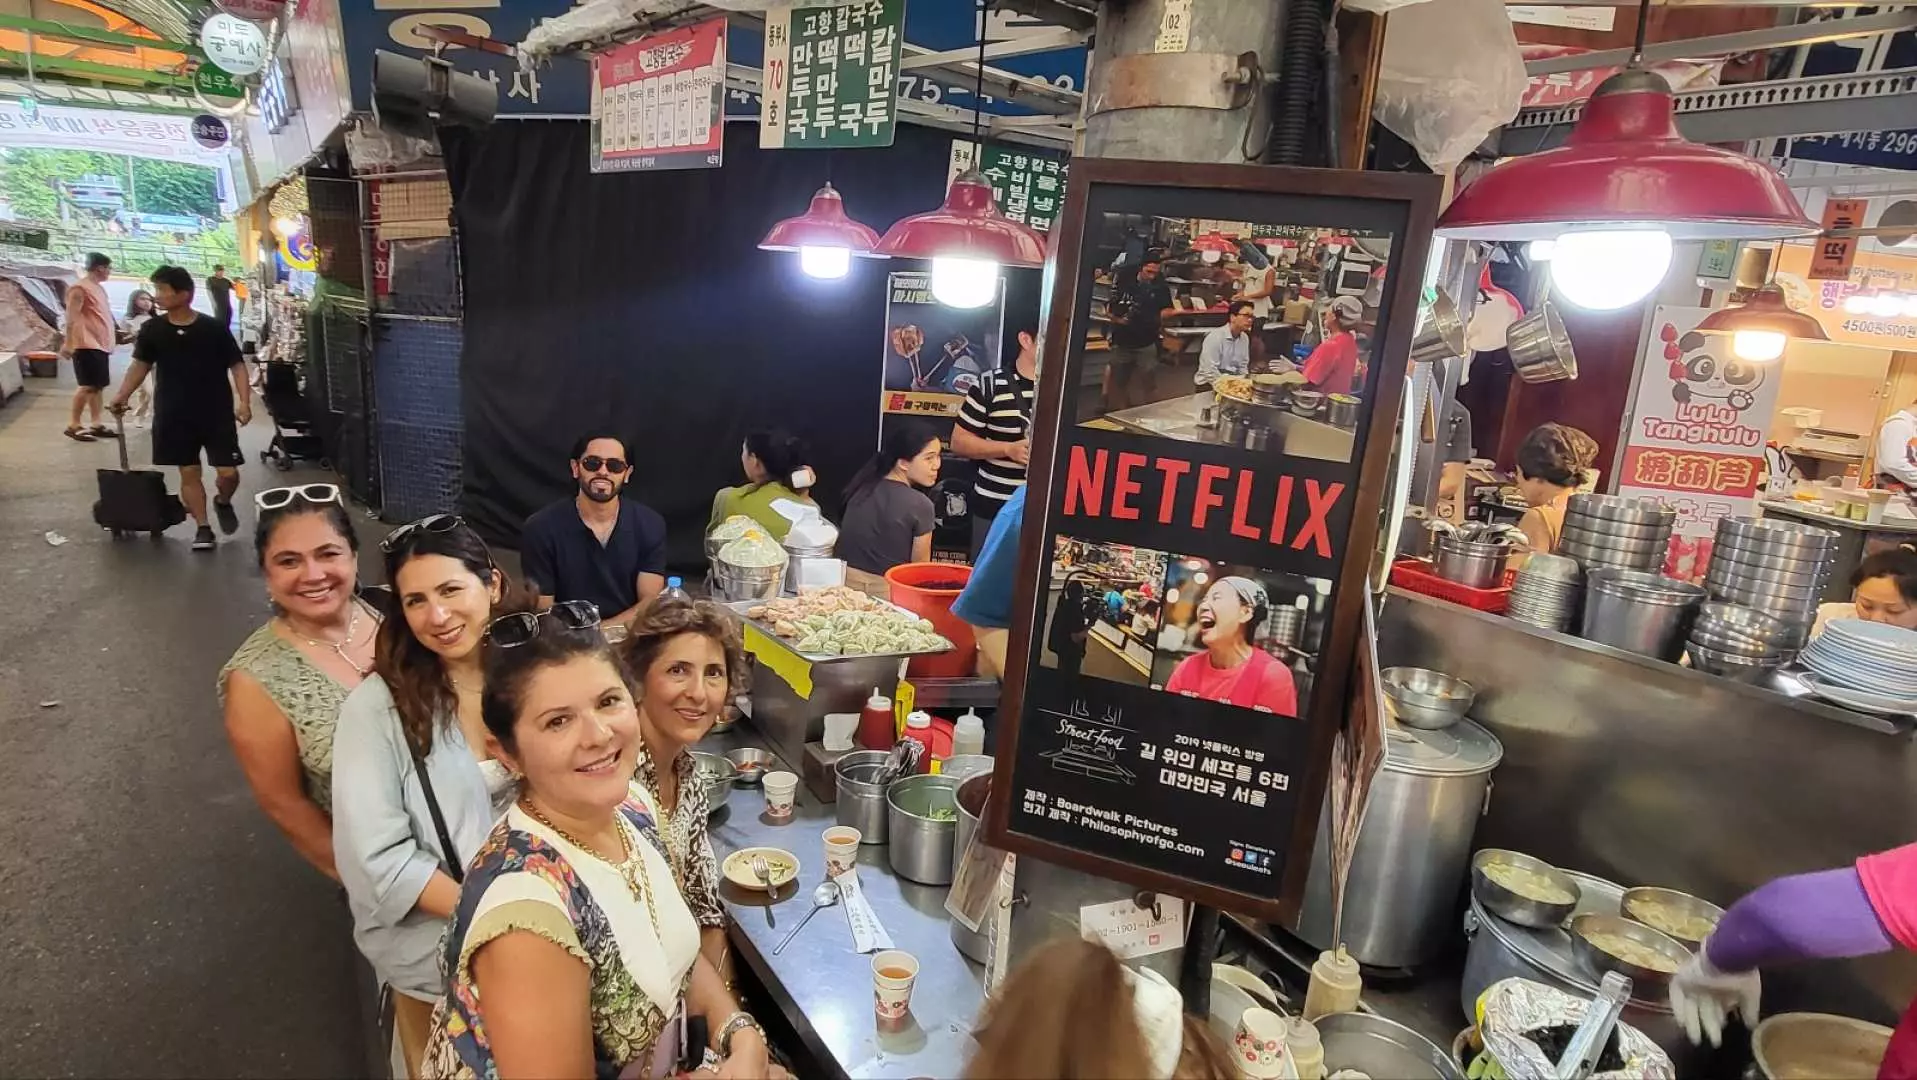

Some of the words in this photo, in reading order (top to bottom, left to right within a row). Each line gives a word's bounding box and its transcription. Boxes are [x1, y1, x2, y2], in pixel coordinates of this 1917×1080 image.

[788, 41, 813, 140] 만두국
[812, 36, 840, 139] 떡만두
[863, 25, 896, 135] 칼만두
[768, 100, 779, 127] 호
[1643, 416, 1761, 447] Tanghulu
[1634, 450, 1753, 491] 糖葫芦
[1063, 444, 1345, 559] NETFLIX
[1055, 718, 1098, 741] Street
[1174, 734, 1200, 748] 2019
[1202, 740, 1241, 758] 넷플릭스
[1244, 749, 1265, 762] 방영
[1140, 742, 1157, 761] 길
[1161, 747, 1197, 770] 위의
[1258, 771, 1290, 791] 6편
[1159, 768, 1227, 798] 대한민국
[1231, 785, 1268, 808] 서울
[1023, 801, 1046, 818] 현지
[1048, 807, 1072, 824] 제작
[1080, 815, 1206, 858] Philosophyofgo.com
[1024, 788, 1047, 804] 제작
[1056, 796, 1121, 823] Boardwalk
[1124, 813, 1179, 837] Pictures
[1224, 857, 1273, 875] @seouleats
